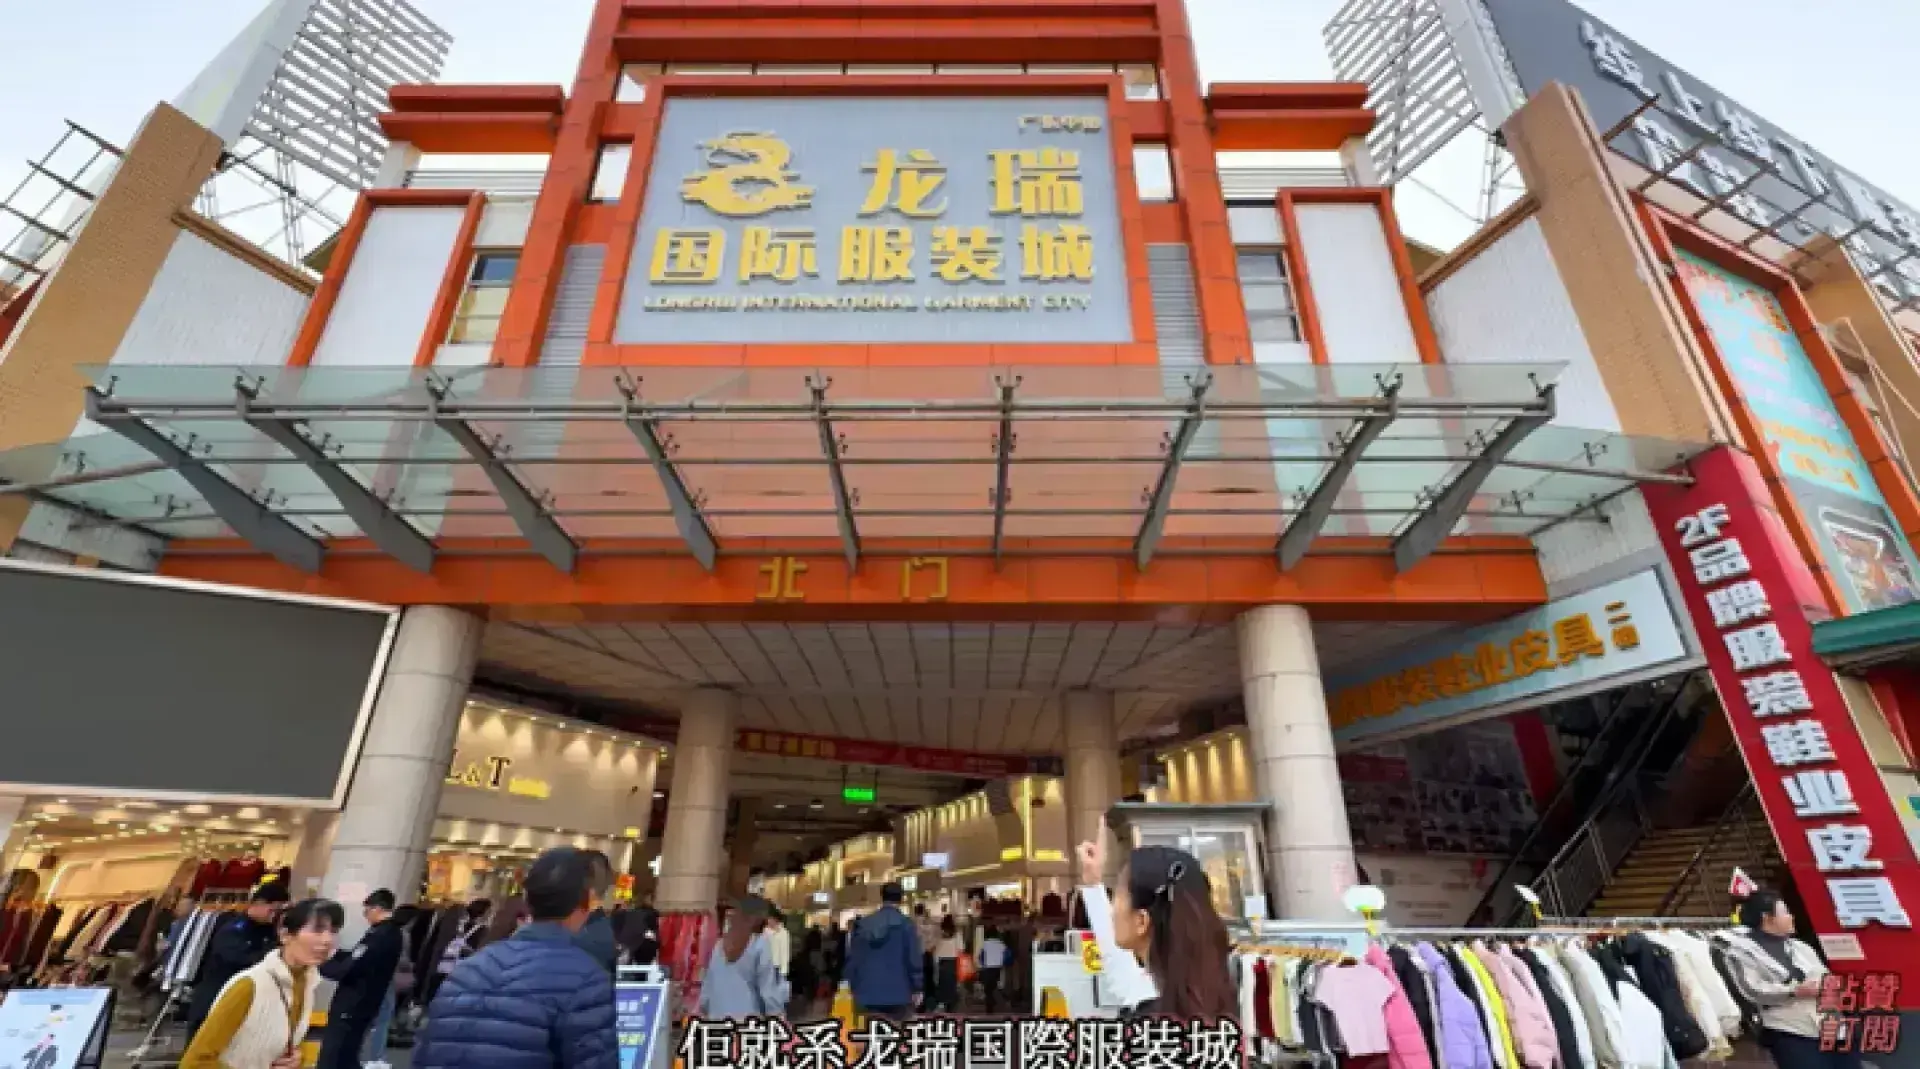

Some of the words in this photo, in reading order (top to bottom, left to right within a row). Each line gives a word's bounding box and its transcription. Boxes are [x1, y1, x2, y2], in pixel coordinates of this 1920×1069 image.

[857, 147, 1085, 217] 龙瑞
[648, 225, 1094, 284] 国际服装城
[756, 556, 949, 599] 北门
[1675, 503, 1912, 929] 2F品牌服装鞋业皮具
